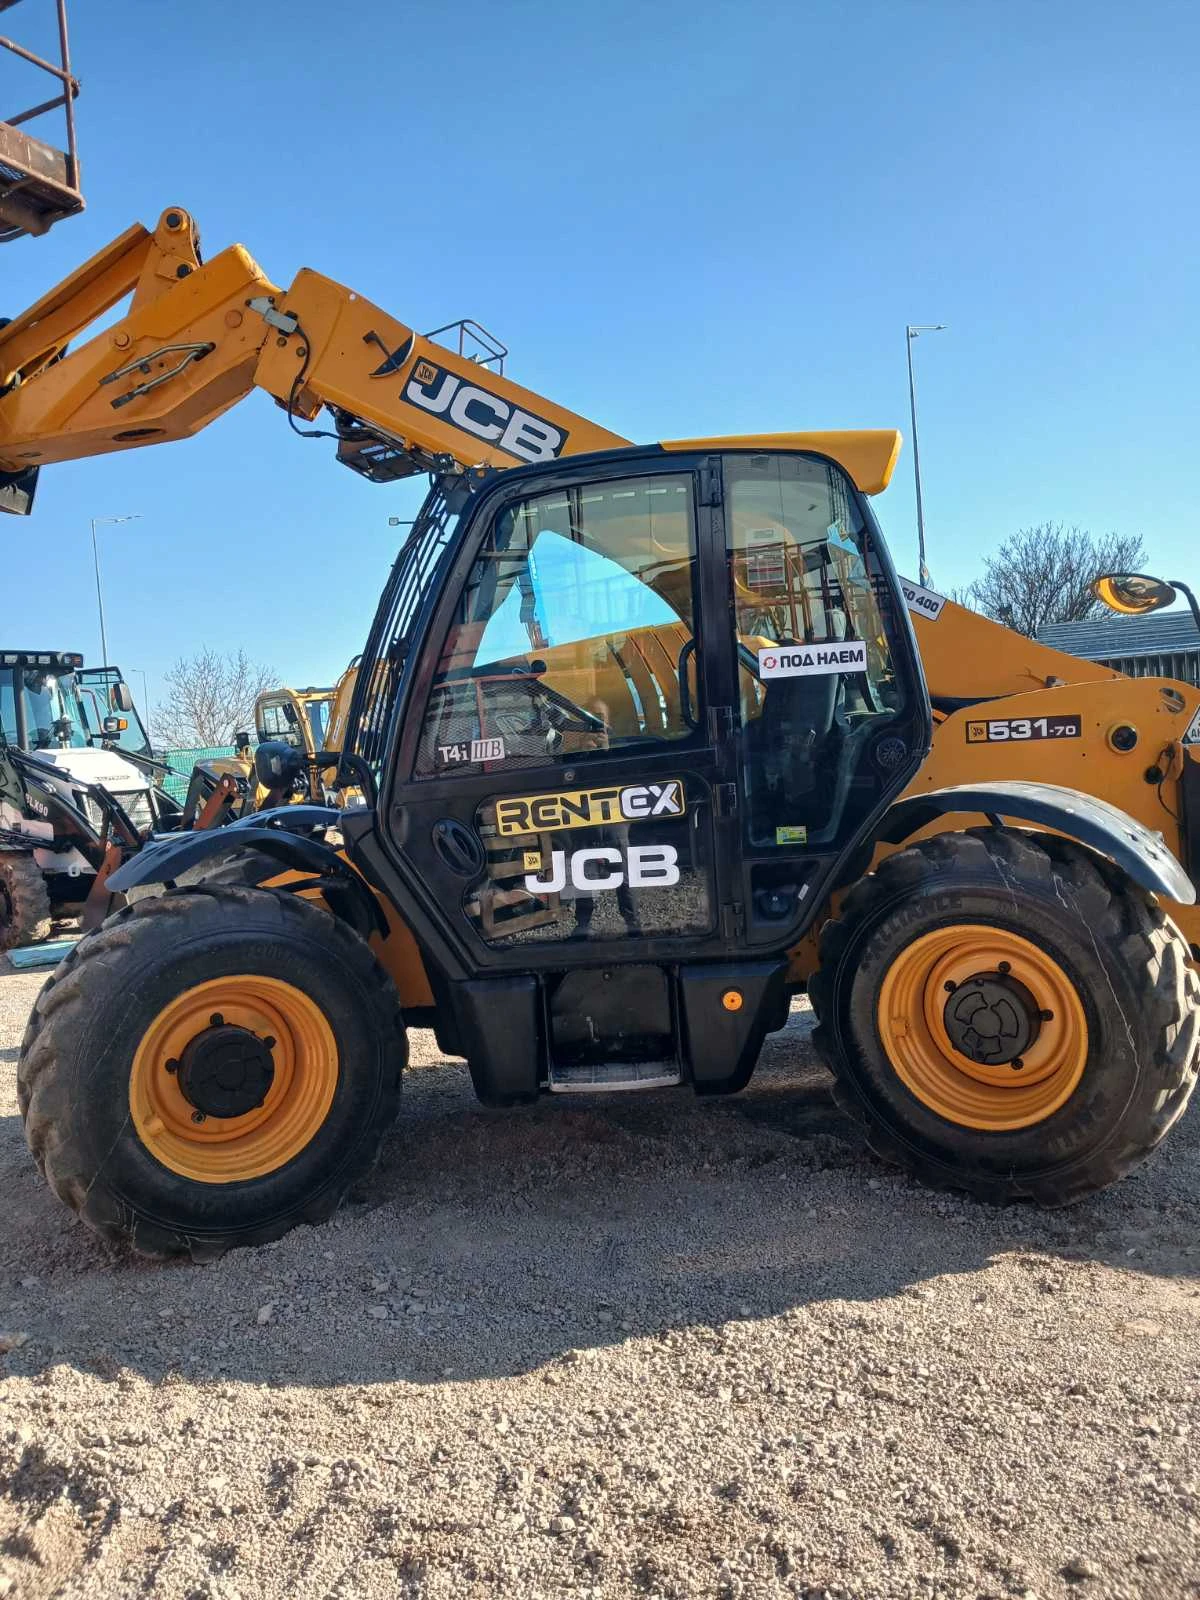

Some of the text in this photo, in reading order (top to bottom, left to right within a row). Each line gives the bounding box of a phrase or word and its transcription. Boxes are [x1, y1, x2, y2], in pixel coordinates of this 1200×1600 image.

[407, 375, 561, 463] JCB
[916, 596, 939, 612] 400
[780, 649, 864, 668] ПОД НАЕМ
[988, 718, 1076, 740] 531-70
[438, 744, 469, 763] T4i
[500, 783, 682, 832] RENTEX
[525, 845, 680, 893] JCB
